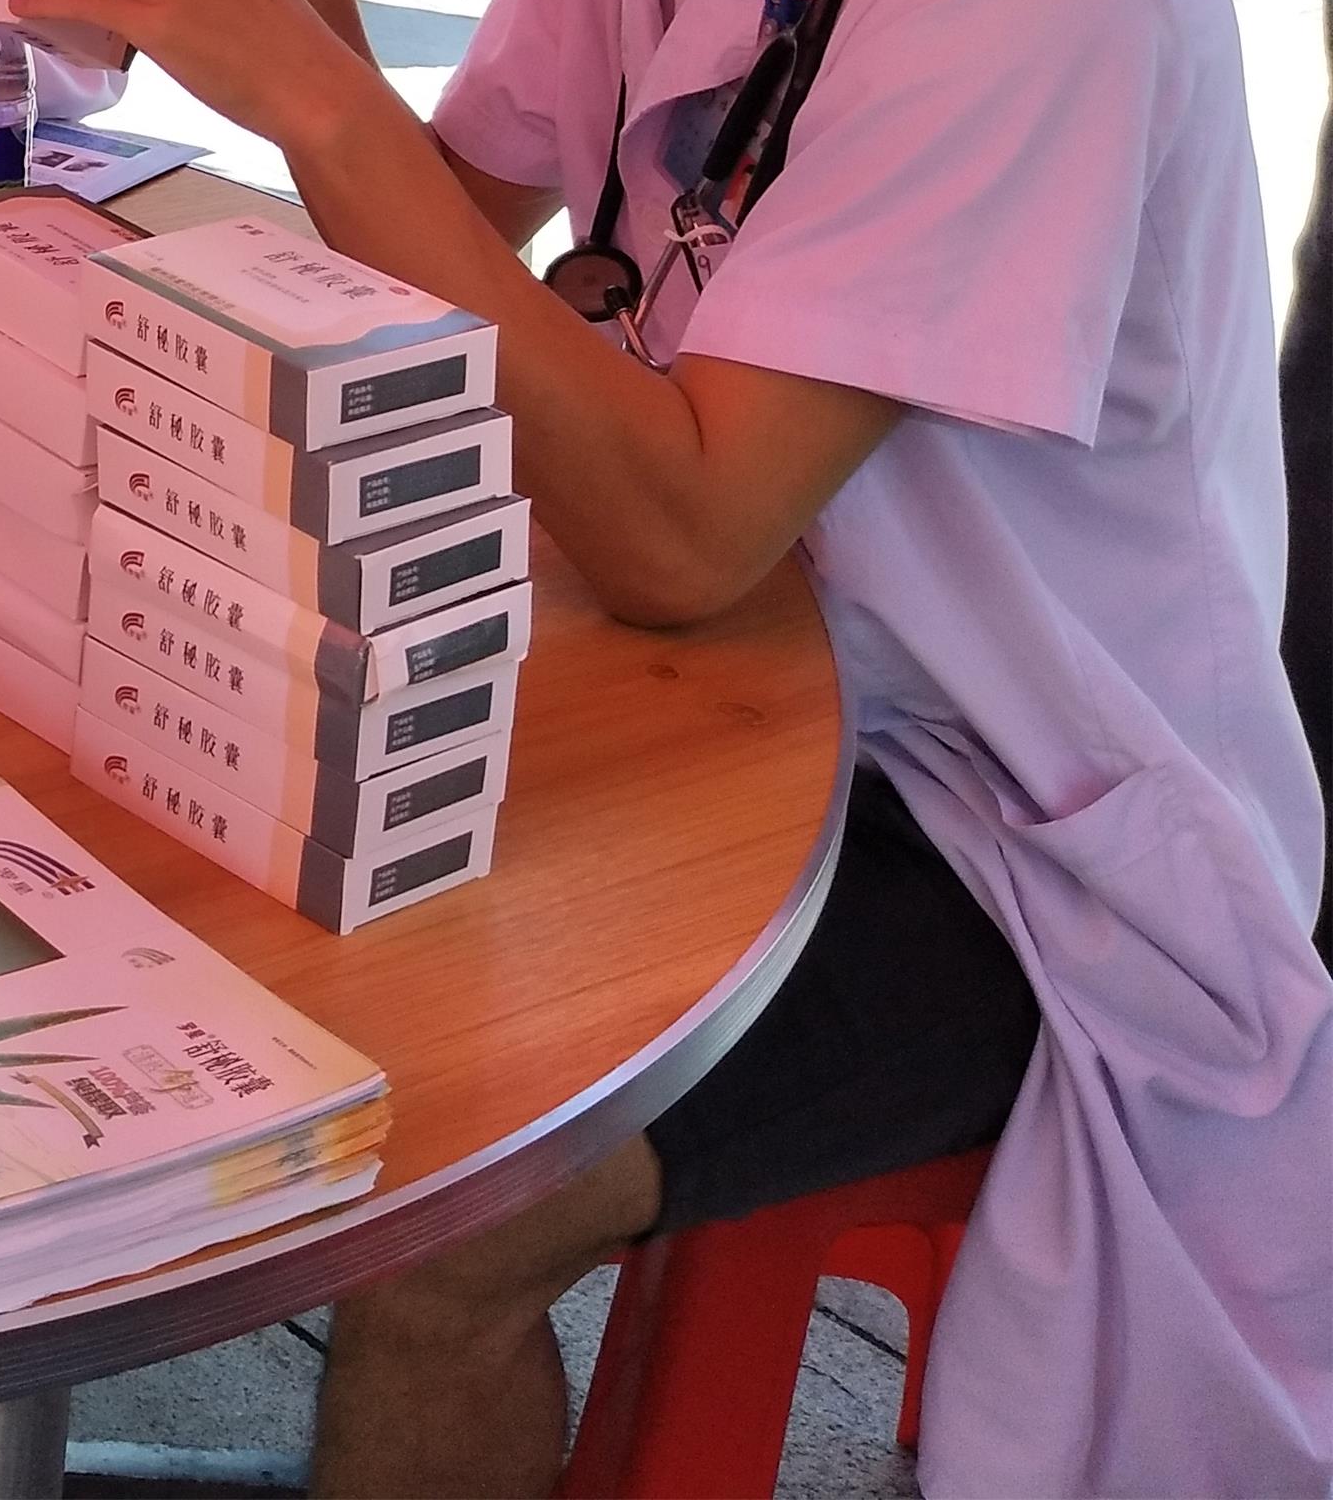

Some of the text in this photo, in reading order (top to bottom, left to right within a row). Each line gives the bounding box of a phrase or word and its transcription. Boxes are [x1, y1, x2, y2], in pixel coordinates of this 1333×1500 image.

[136, 312, 210, 375] 舒秘胶囊
[148, 401, 228, 466] 舒秘胶囊
[165, 487, 248, 554] 舒秘胶囊
[157, 564, 246, 632] 舒秘胶囊
[159, 627, 247, 696] 舒秘胶囊
[153, 701, 242, 772] 舒秘胶囊
[142, 773, 229, 845] 舒秘胶囊
